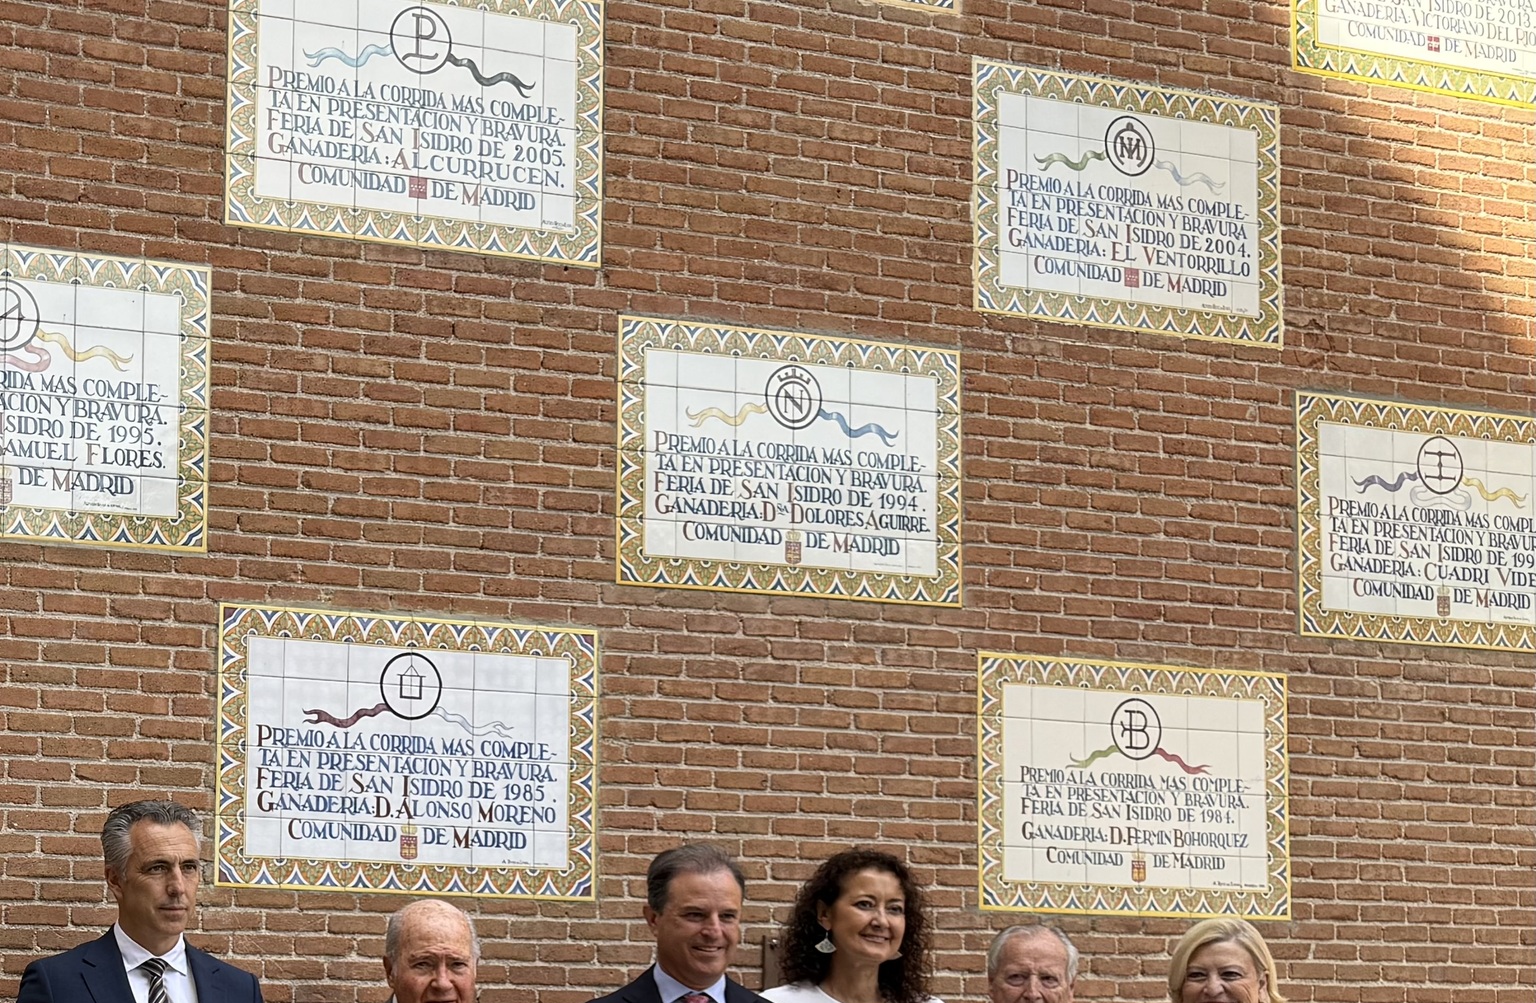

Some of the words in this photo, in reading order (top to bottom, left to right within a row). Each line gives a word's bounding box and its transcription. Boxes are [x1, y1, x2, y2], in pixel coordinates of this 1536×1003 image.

[1475, 4, 1494, 21] DE
[1348, 19, 1425, 48] COMUNIDAD
[1444, 38, 1461, 54] DE
[1464, 39, 1516, 63] MADRID
[266, 108, 324, 136] FERIA
[328, 120, 354, 140] DE
[359, 120, 403, 146] SAN
[411, 127, 472, 155] ISIDRO
[477, 139, 505, 159] DE
[1006, 206, 1054, 231] FERIA
[1057, 217, 1078, 234] DE
[1081, 216, 1118, 240] SAN
[1125, 222, 1174, 247] ISIDRO
[1179, 233, 1202, 250] DE
[1110, 240, 1136, 262] EL
[1142, 245, 1250, 277] VENTORRILLO
[18, 466, 48, 487] DE
[51, 466, 134, 494] MADRID
[788, 502, 864, 528] DOLORES
[682, 520, 782, 545] COMUNIDAD
[805, 531, 830, 549] DE
[832, 532, 899, 555] MADRID
[1328, 532, 1371, 554] FERIA
[1375, 539, 1394, 556] DE
[1397, 539, 1430, 559] SAN
[1437, 542, 1482, 564] ISIDRO
[1486, 549, 1507, 566] DE
[1423, 560, 1489, 583] CUADRI
[1352, 577, 1434, 601] COMUNIDAD
[1453, 588, 1472, 604] DE
[1475, 588, 1530, 609] MADRID
[256, 767, 314, 792] FERIA
[318, 774, 344, 793] DE
[348, 771, 393, 795] SAN
[401, 773, 462, 798] ISIDRO
[467, 780, 497, 799] DE
[396, 796, 472, 820] ALONSO
[476, 799, 556, 823] MORENO
[287, 818, 396, 845] COMUNIDAD
[423, 827, 449, 847] DE
[452, 824, 527, 849] MADRID
[1046, 846, 1123, 866] COMUNIDAD
[1152, 852, 1170, 868] DE
[1171, 852, 1225, 870] MADRID
